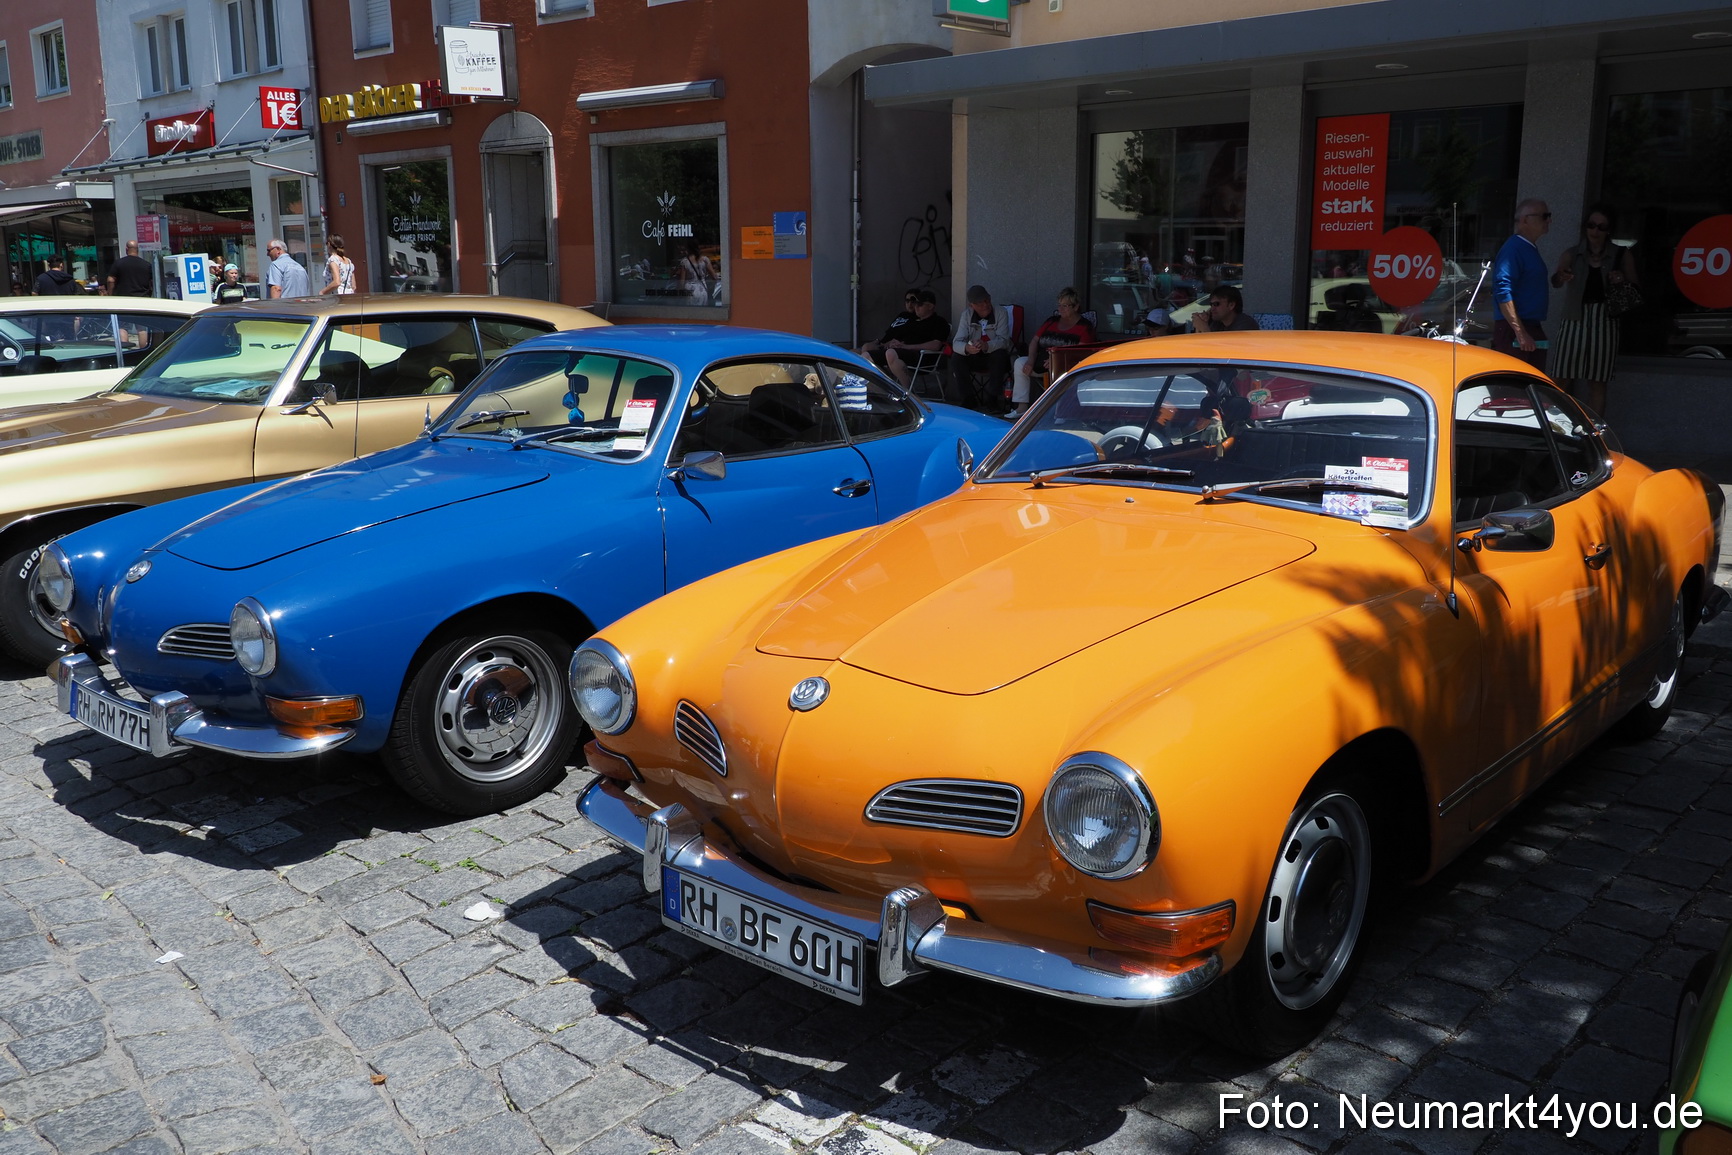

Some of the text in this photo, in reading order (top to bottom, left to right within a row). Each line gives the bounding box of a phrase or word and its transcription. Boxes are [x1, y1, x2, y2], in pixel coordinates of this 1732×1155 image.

[466, 57, 496, 66] KAFFEE
[266, 90, 296, 101] ALLES
[319, 94, 352, 123] DER
[352, 84, 419, 119] BÄCKER
[267, 101, 298, 126] 1€
[1325, 133, 1370, 145] Riesen-
[1324, 147, 1373, 160] auswahl
[1323, 163, 1375, 176] aktueller
[1322, 179, 1370, 191] Modelle
[1321, 196, 1374, 214] stark
[1320, 220, 1374, 232] reduziert
[417, 233, 436, 241] FRISCH
[642, 220, 665, 246] Café
[189, 261, 200, 279] P
[1373, 254, 1436, 279] 50%
[77, 687, 91, 722] RH
[98, 699, 116, 734] RM
[119, 708, 151, 748] 77H
[669, 879, 859, 988] D RH BF 60H
[819, 983, 837, 996] DEKRA
